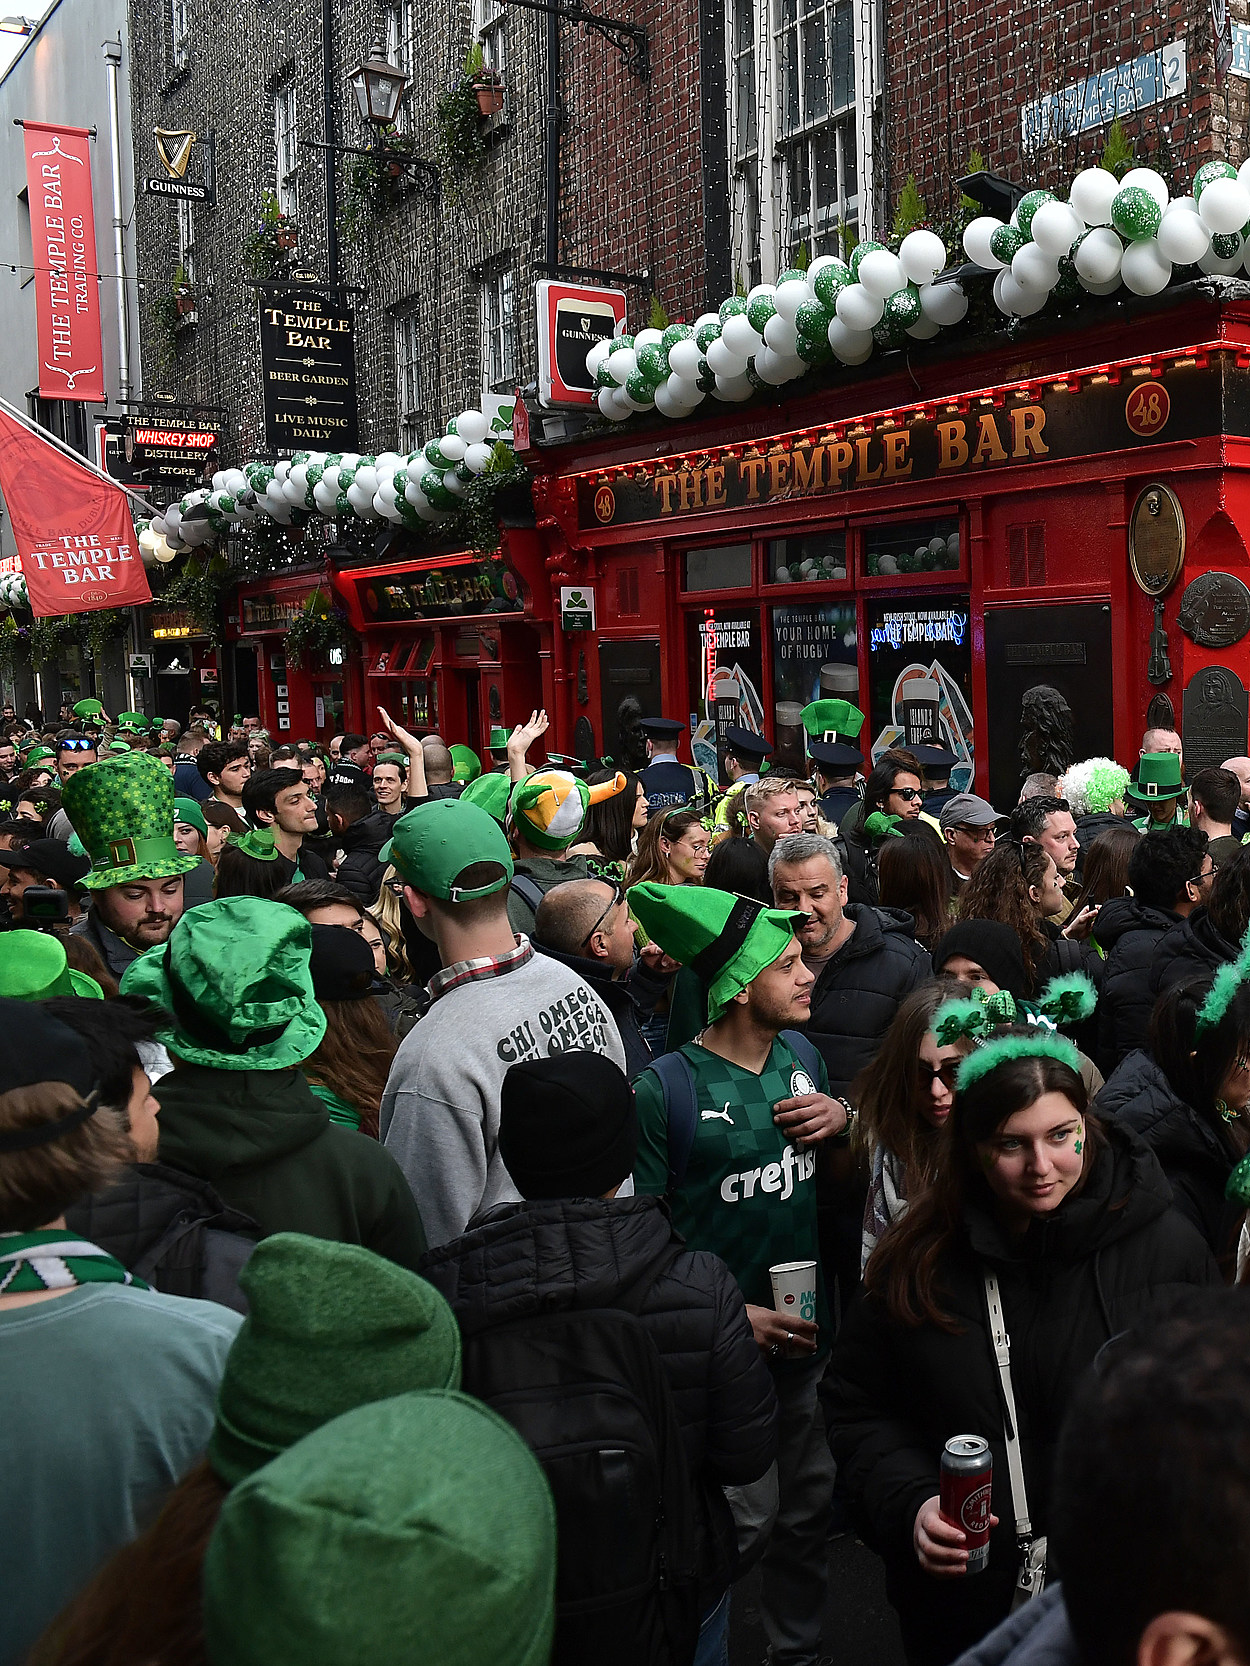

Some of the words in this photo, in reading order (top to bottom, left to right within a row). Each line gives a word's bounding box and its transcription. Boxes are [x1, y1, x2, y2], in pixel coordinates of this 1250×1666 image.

[1168, 56, 1180, 83] 2
[1118, 87, 1143, 109] BAR
[42, 164, 63, 210] BAR
[150, 180, 205, 197] GUINNESS
[71, 215, 84, 239] CO.
[46, 215, 70, 309] TEMPLE
[72, 243, 88, 314] TRADING
[293, 300, 322, 312] THE
[264, 308, 350, 333] TEMPLE
[52, 314, 72, 361] THE
[285, 330, 333, 350] BAR
[269, 371, 300, 382] BEER
[302, 374, 349, 386] GARDEN
[1133, 391, 1162, 427] 48
[127, 416, 149, 426] THE
[152, 418, 196, 430] TEMPLE
[198, 422, 221, 431] BAR
[275, 413, 304, 425] LIVE
[307, 416, 348, 427] MUSIC
[136, 429, 186, 447] WHISKEY
[187, 433, 216, 448] SHOP
[292, 428, 332, 439] DAILY
[144, 449, 209, 460] DISTILLERY
[654, 467, 729, 514] THE
[738, 429, 913, 500] TEMPLE
[937, 404, 1050, 469] BAR
[160, 466, 197, 476] STORE
[598, 491, 612, 517] 48
[58, 534, 101, 550] THE
[31, 544, 135, 570] TEMPLE
[62, 565, 116, 585] BAR
[737, 631, 750, 647] BAR
[776, 627, 803, 642] YOUR
[807, 625, 837, 640] HOME
[781, 645, 793, 659] OF
[799, 644, 830, 659] RUGBY
[497, 1020, 536, 1062] CHI
[721, 1144, 817, 1203] crefis
[970, 1520, 983, 1529] RED
